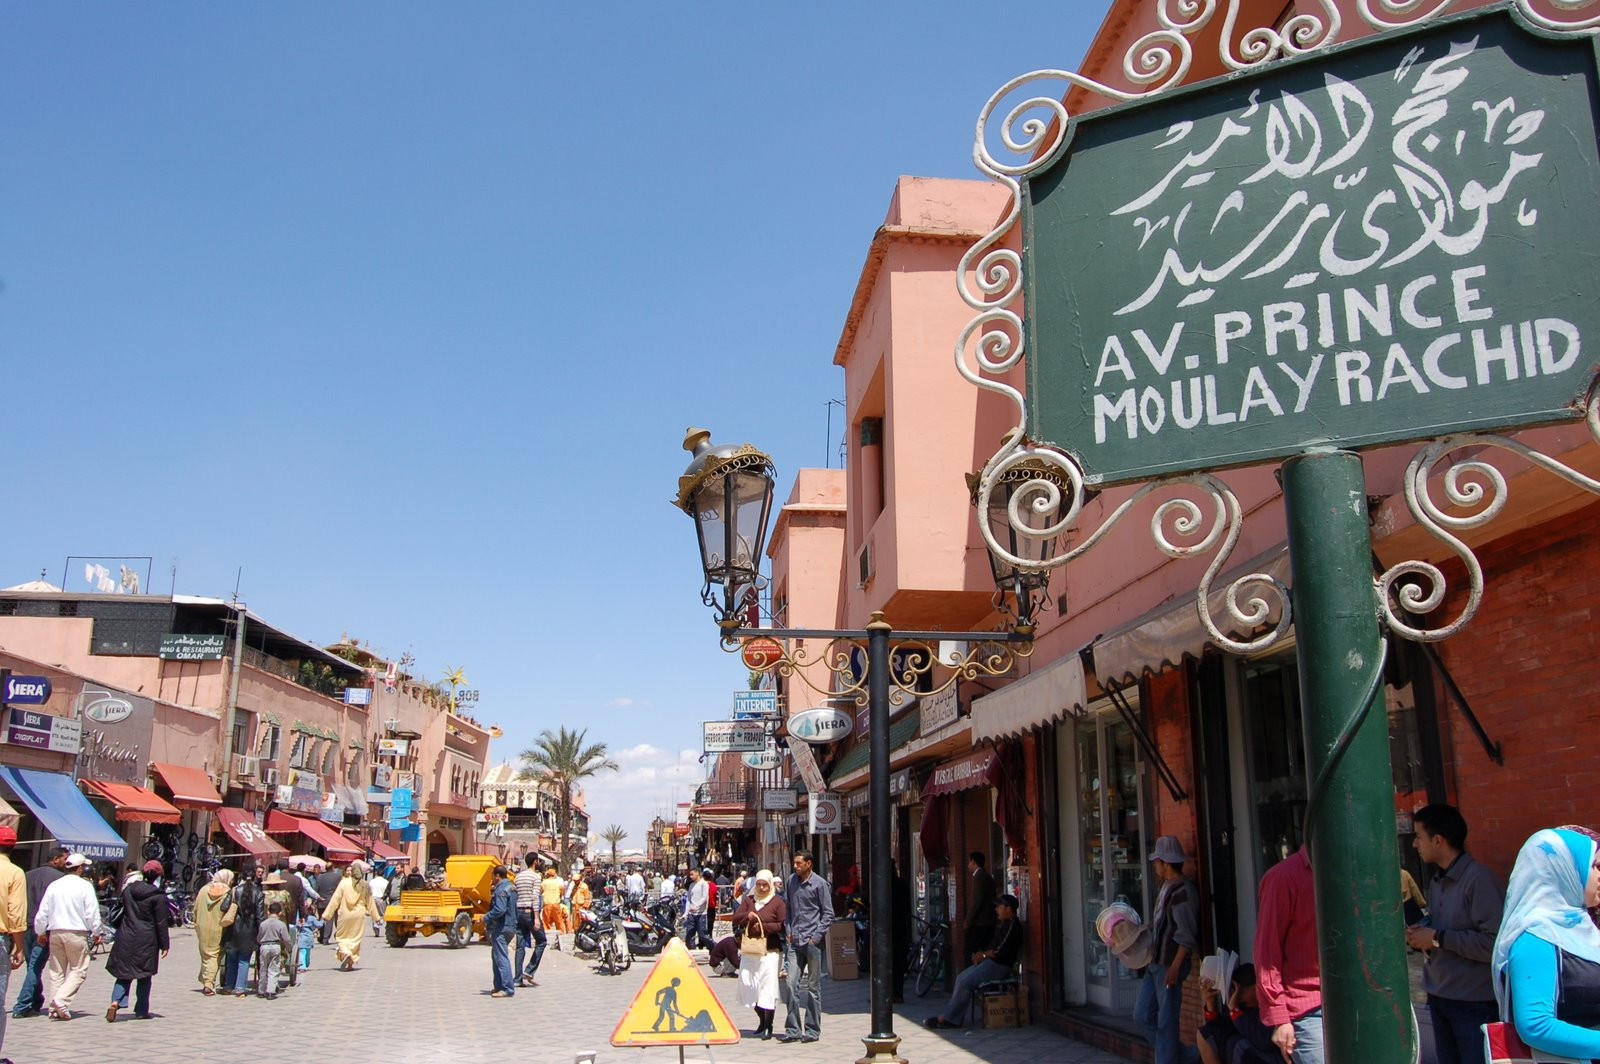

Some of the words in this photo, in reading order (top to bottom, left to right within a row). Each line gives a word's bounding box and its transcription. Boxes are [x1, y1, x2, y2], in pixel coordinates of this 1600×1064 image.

[1094, 321, 1200, 386] AV.
[1214, 265, 1494, 365] PRINCE
[1094, 353, 1324, 444] MOULAY
[1335, 317, 1582, 406] RACHID
[182, 646, 223, 654] RESTAURANT
[8, 679, 44, 700] SIERA
[104, 705, 126, 718] SIERA
[736, 699, 775, 712] INTERNET
[23, 712, 41, 726] SIERA
[815, 718, 846, 736] SIERA
[14, 733, 45, 744] DIGIFLAT
[760, 754, 780, 766] SIERA
[105, 846, 124, 858] WAFA
